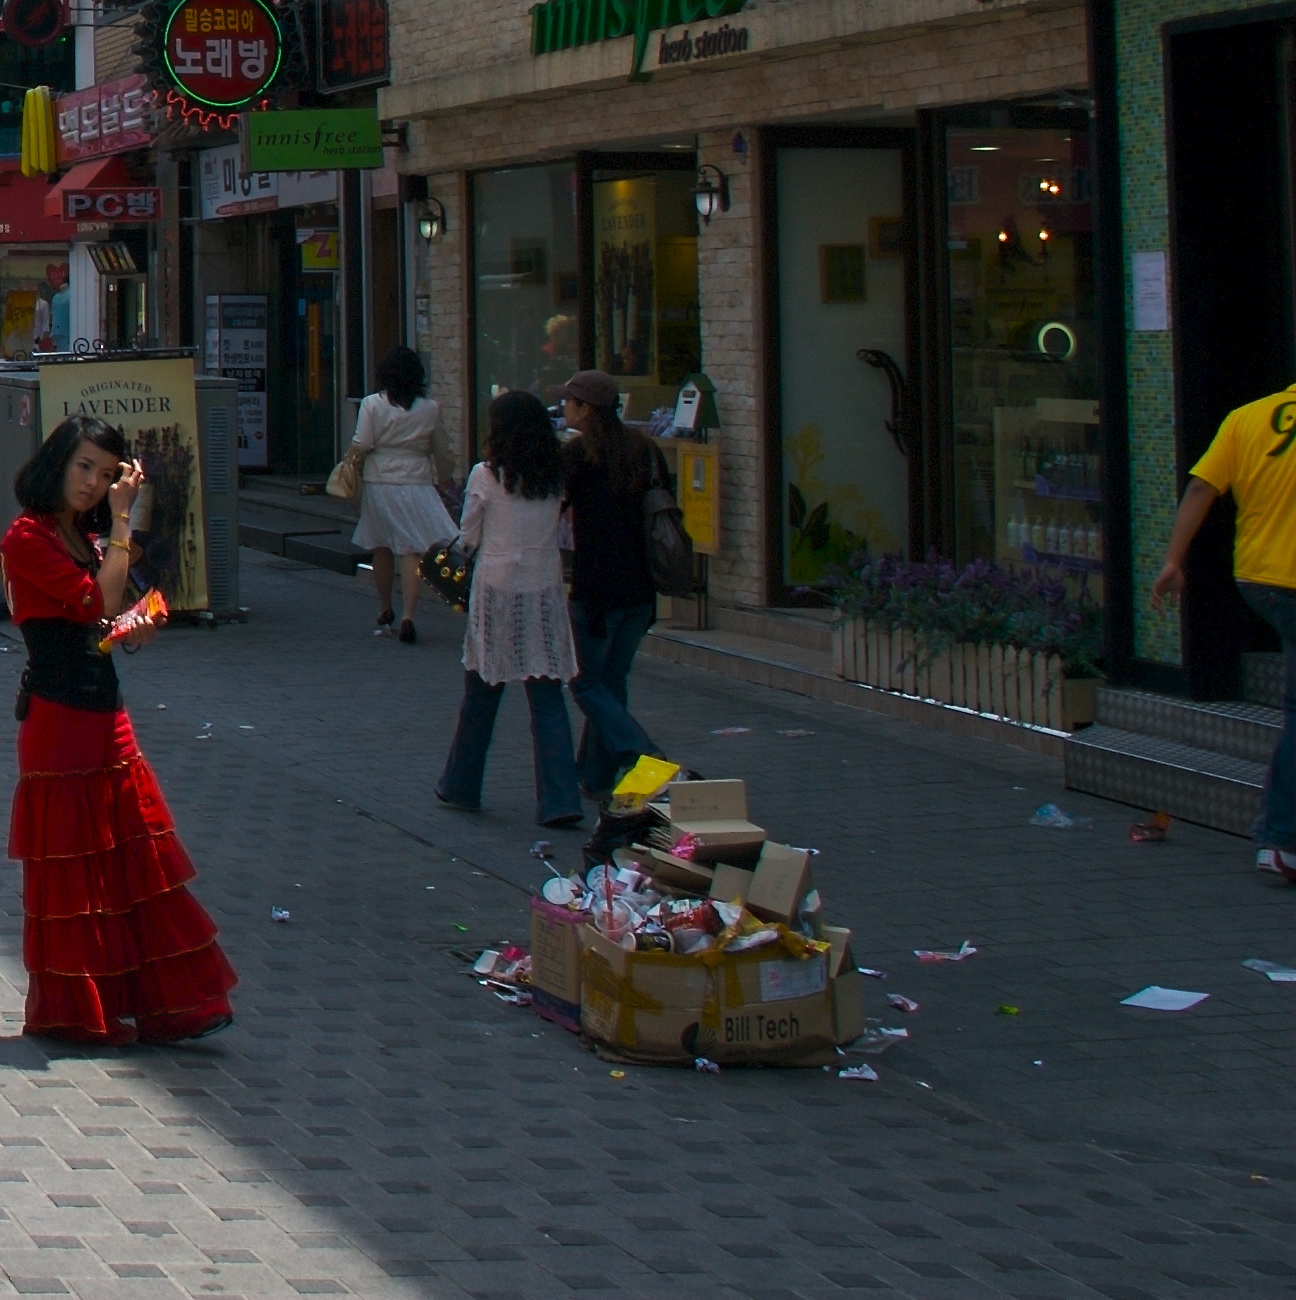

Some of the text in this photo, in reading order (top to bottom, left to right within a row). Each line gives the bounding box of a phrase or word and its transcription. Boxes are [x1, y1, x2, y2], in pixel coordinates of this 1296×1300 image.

[183, 7, 255, 34] 필승코리아
[657, 22, 748, 66] herb station
[174, 38, 269, 80] 노래방
[58, 88, 147, 144] 맥도날드
[257, 123, 358, 150] innisfree
[67, 192, 157, 219] PC방
[80, 380, 153, 399] ORIGINATED
[63, 396, 172, 418] LAVENDER
[724, 1012, 801, 1043] Bill Tech
